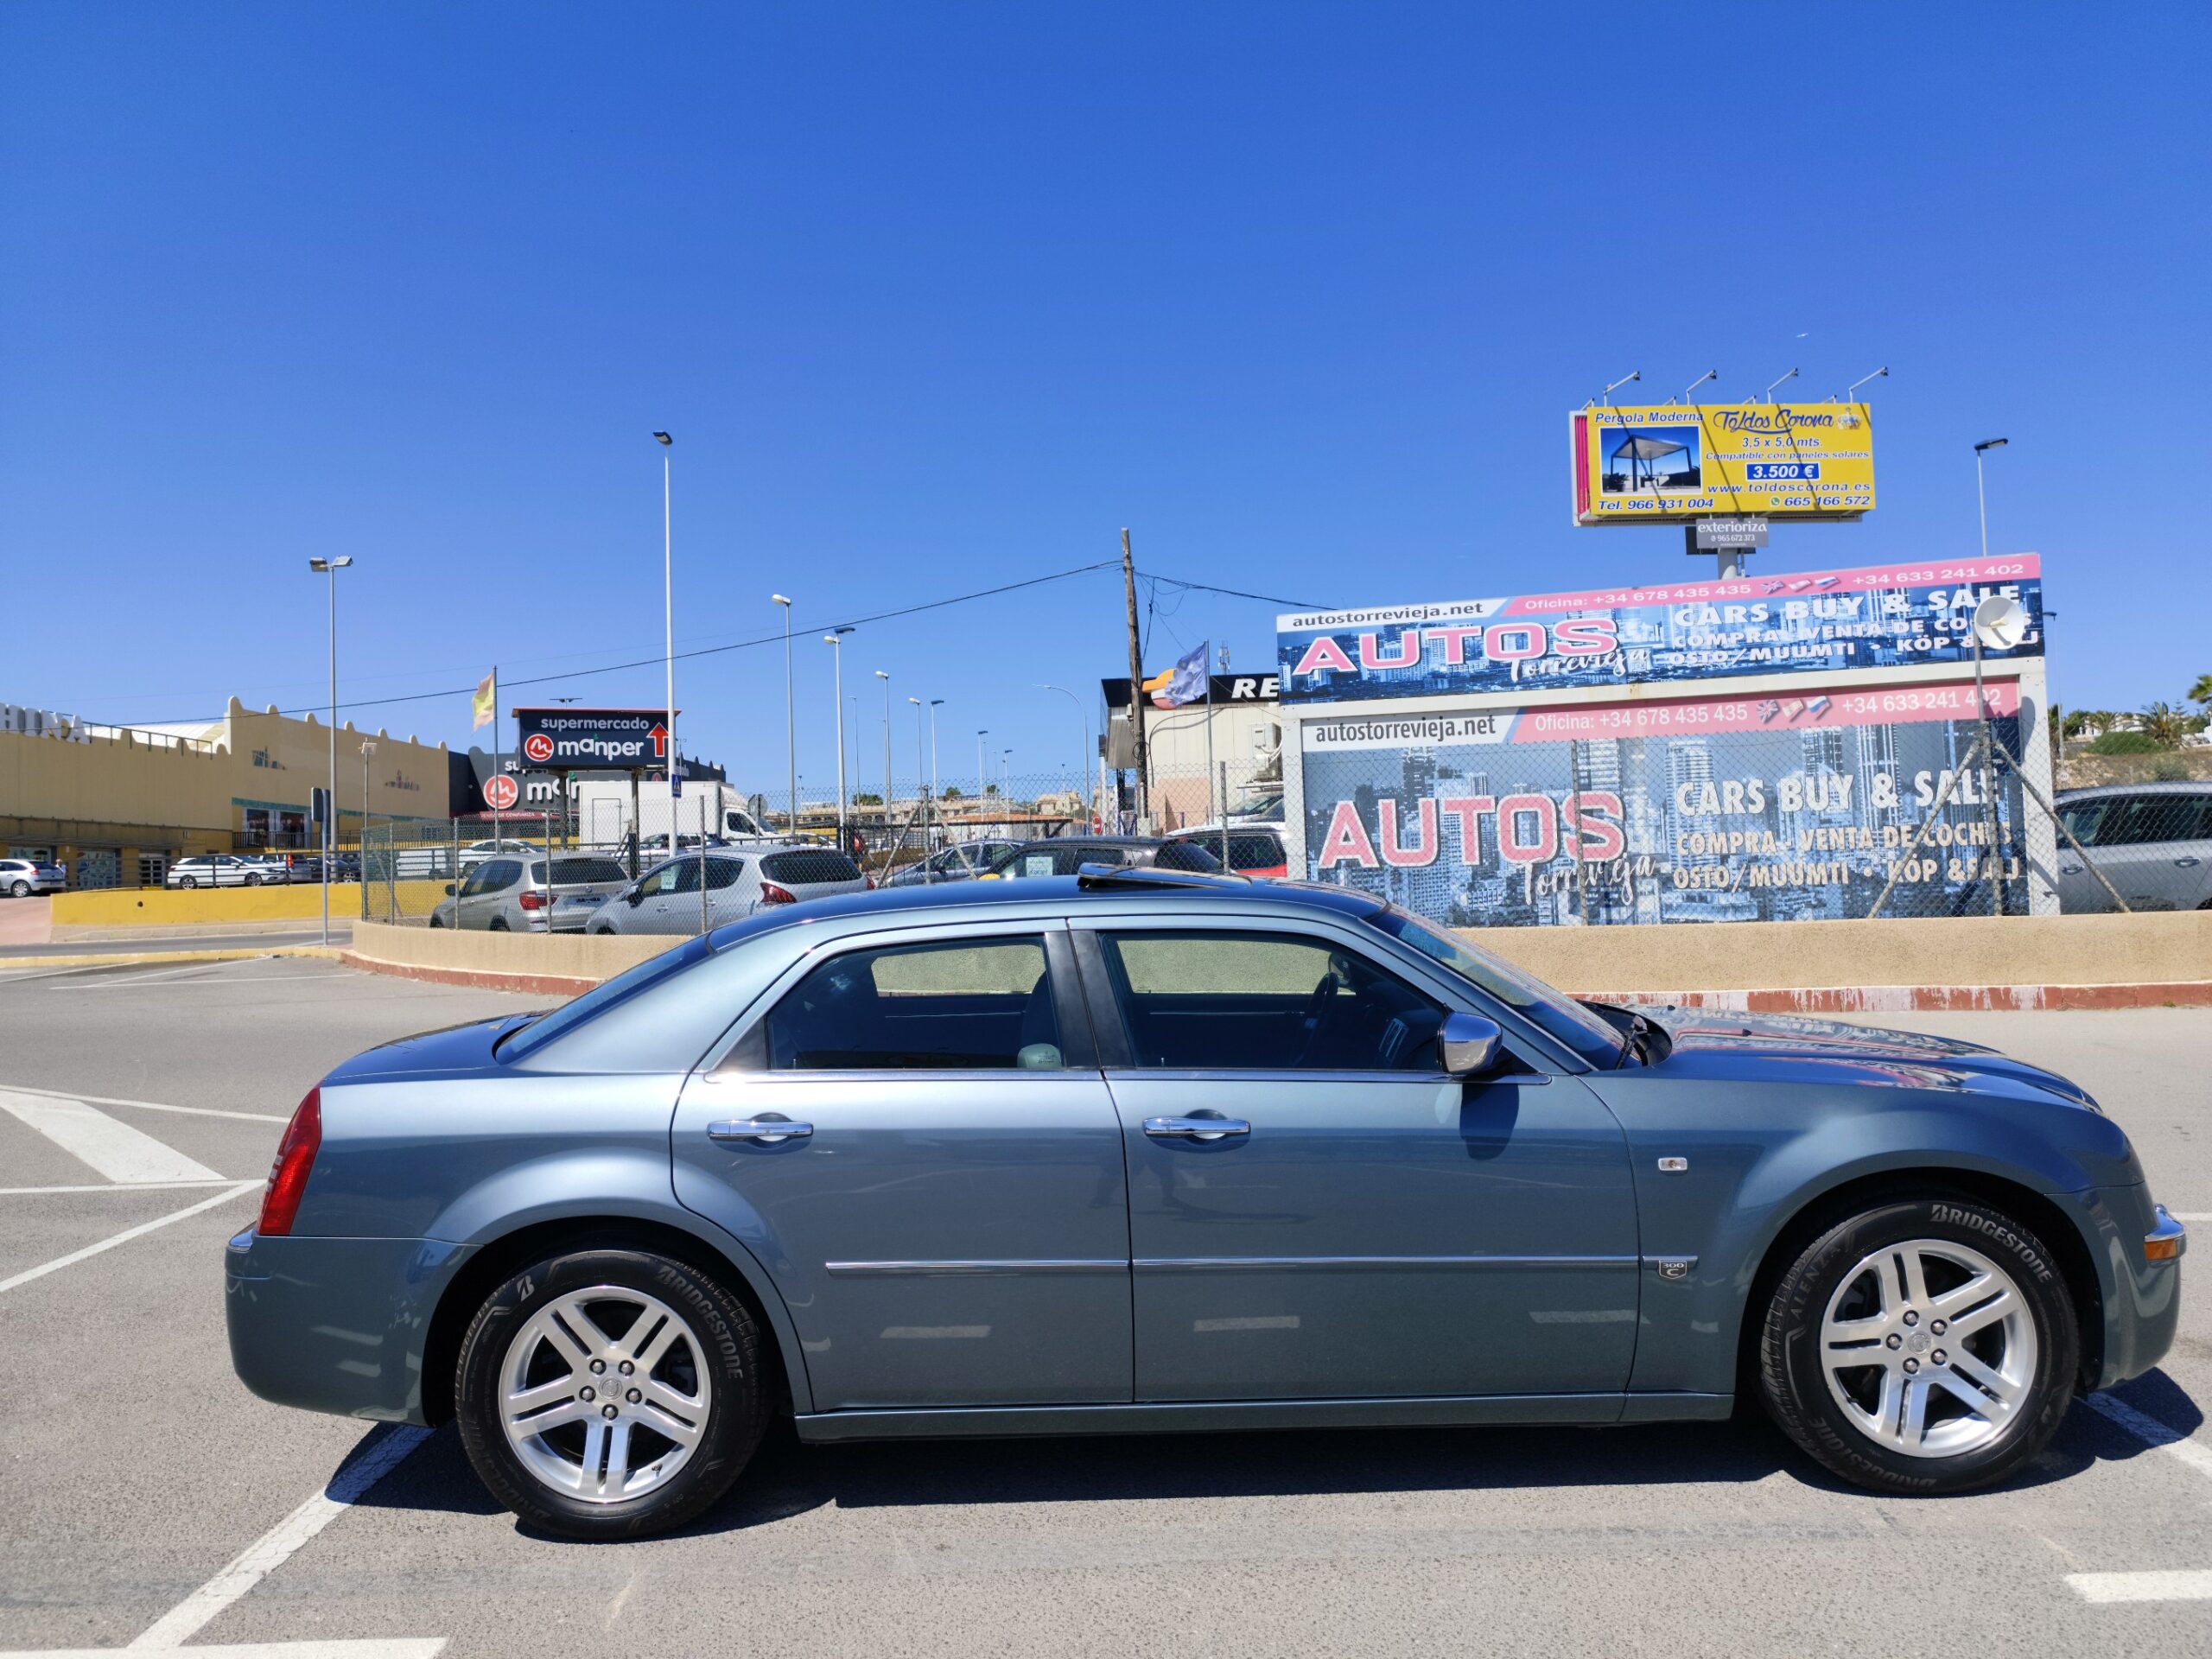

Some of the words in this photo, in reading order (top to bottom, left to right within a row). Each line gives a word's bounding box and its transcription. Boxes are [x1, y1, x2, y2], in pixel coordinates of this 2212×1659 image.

[1649, 411, 1703, 423] Moderna
[1713, 410, 1770, 433] Toldos
[1775, 409, 1834, 429] Corona
[1742, 437, 1760, 448] 3,5
[1775, 436, 1793, 448] 5,0
[1706, 452, 1764, 461] Compatible
[1789, 451, 1828, 461] paneles
[1752, 465, 1799, 479] 3.500
[1803, 464, 1815, 478] €
[1707, 483, 1871, 493] www.toldoscorona.es
[1783, 496, 1811, 506] 665
[1815, 496, 1840, 505] 166
[1844, 495, 1871, 505] 572
[1599, 500, 1623, 510] Tel.
[1627, 499, 1654, 510] 966
[1658, 499, 1682, 509] 931
[1688, 499, 1713, 508] 004
[1697, 521, 1767, 532] exterioriza
[1525, 596, 1589, 610] Oficina:
[1593, 594, 1628, 604] +34
[1633, 590, 1669, 601] 678
[1674, 588, 1709, 598] 435
[1714, 584, 1751, 595] 435
[1853, 574, 1891, 586] +34
[1896, 571, 1935, 582] 633
[1941, 568, 1979, 579] 241
[1984, 563, 2024, 575] 402
[1293, 602, 1484, 627] autostorrevieja.net
[1674, 602, 1770, 627] CARS
[1784, 596, 1865, 620] BUY
[1883, 594, 1911, 613] &
[1292, 617, 1618, 676] AUTOS
[1673, 629, 1782, 648] COMPRA
[1805, 622, 1885, 639] VENTA
[1893, 620, 1924, 634] DE
[1897, 634, 1950, 652] KÖP
[1509, 646, 1651, 682] Torrevieja
[1535, 715, 1594, 731] Oficina:
[1599, 711, 1632, 727] +34
[1637, 709, 1670, 726] 678
[1675, 706, 1708, 723] 435
[1713, 703, 1748, 721] 435
[1843, 695, 1878, 714] +34
[1883, 694, 1919, 712] 633
[1925, 691, 1961, 709] 241
[540, 716, 650, 733] supermercado
[1315, 715, 1496, 743] autostorrevieja.net
[557, 738, 645, 761] manper
[1676, 779, 1765, 817] CARS
[1780, 774, 1854, 812] BUY
[1871, 772, 1900, 809] &
[1318, 790, 1626, 869] AUTOS
[1676, 830, 1777, 856] COMPRA
[1800, 826, 1875, 851] VENTA
[1883, 824, 1914, 849] DE
[1929, 1204, 2054, 1284] BRIDGESTONE
[1791, 1246, 1840, 1320] ALENZA
[657, 1265, 744, 1380] BRIDGESTONE
